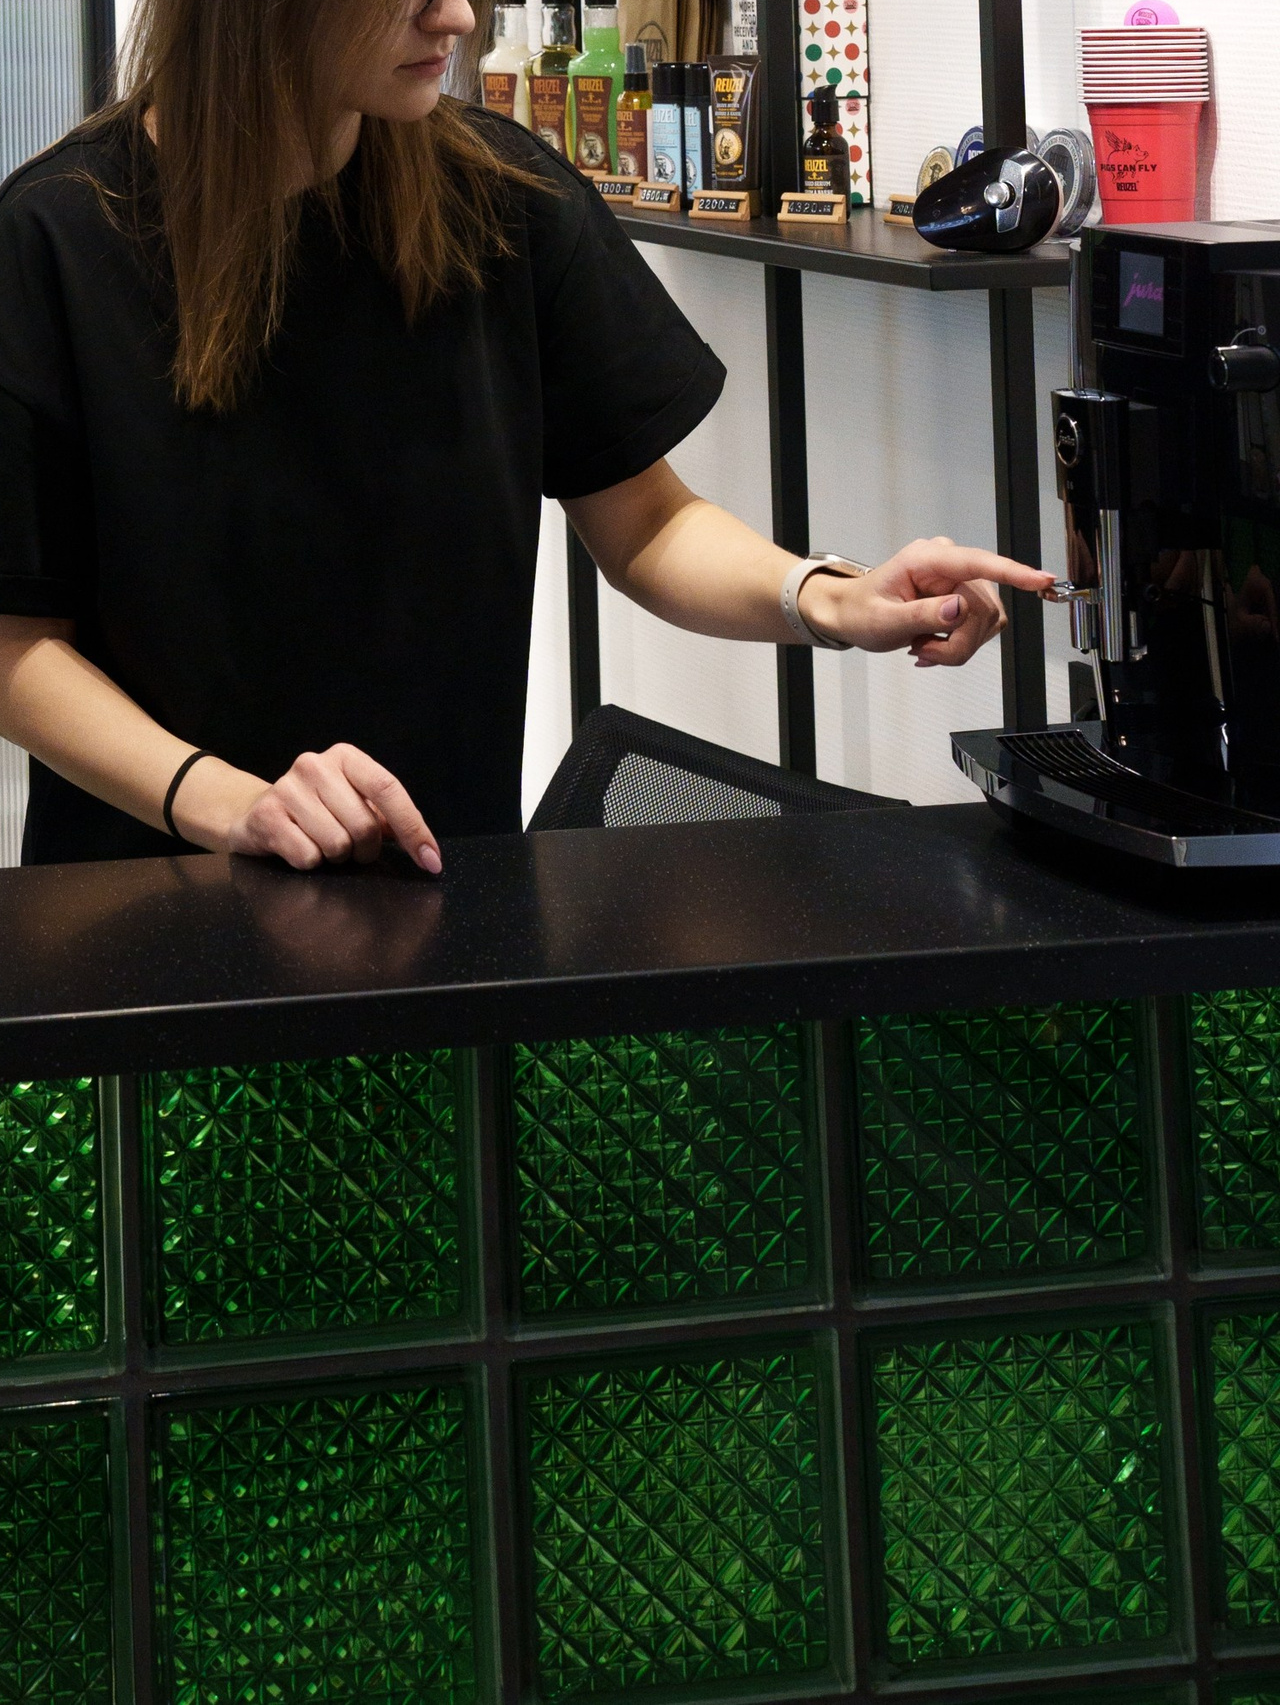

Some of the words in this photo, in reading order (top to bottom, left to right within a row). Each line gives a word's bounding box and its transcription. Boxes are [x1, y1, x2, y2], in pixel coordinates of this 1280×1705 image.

[739, 1, 755, 13] MORE
[741, 14, 757, 26] PROD
[742, 39, 754, 51] AND
[486, 75, 509, 91] REUZEL
[534, 79, 561, 94] REUZEL
[578, 78, 604, 92] REUZEL
[715, 78, 744, 92] REUZEL
[1100, 164, 1116, 172] PIGS
[1117, 164, 1136, 172] CAN
[1138, 164, 1157, 172] FLY
[1116, 182, 1138, 192] REUZEL
[1123, 273, 1163, 307] jura
